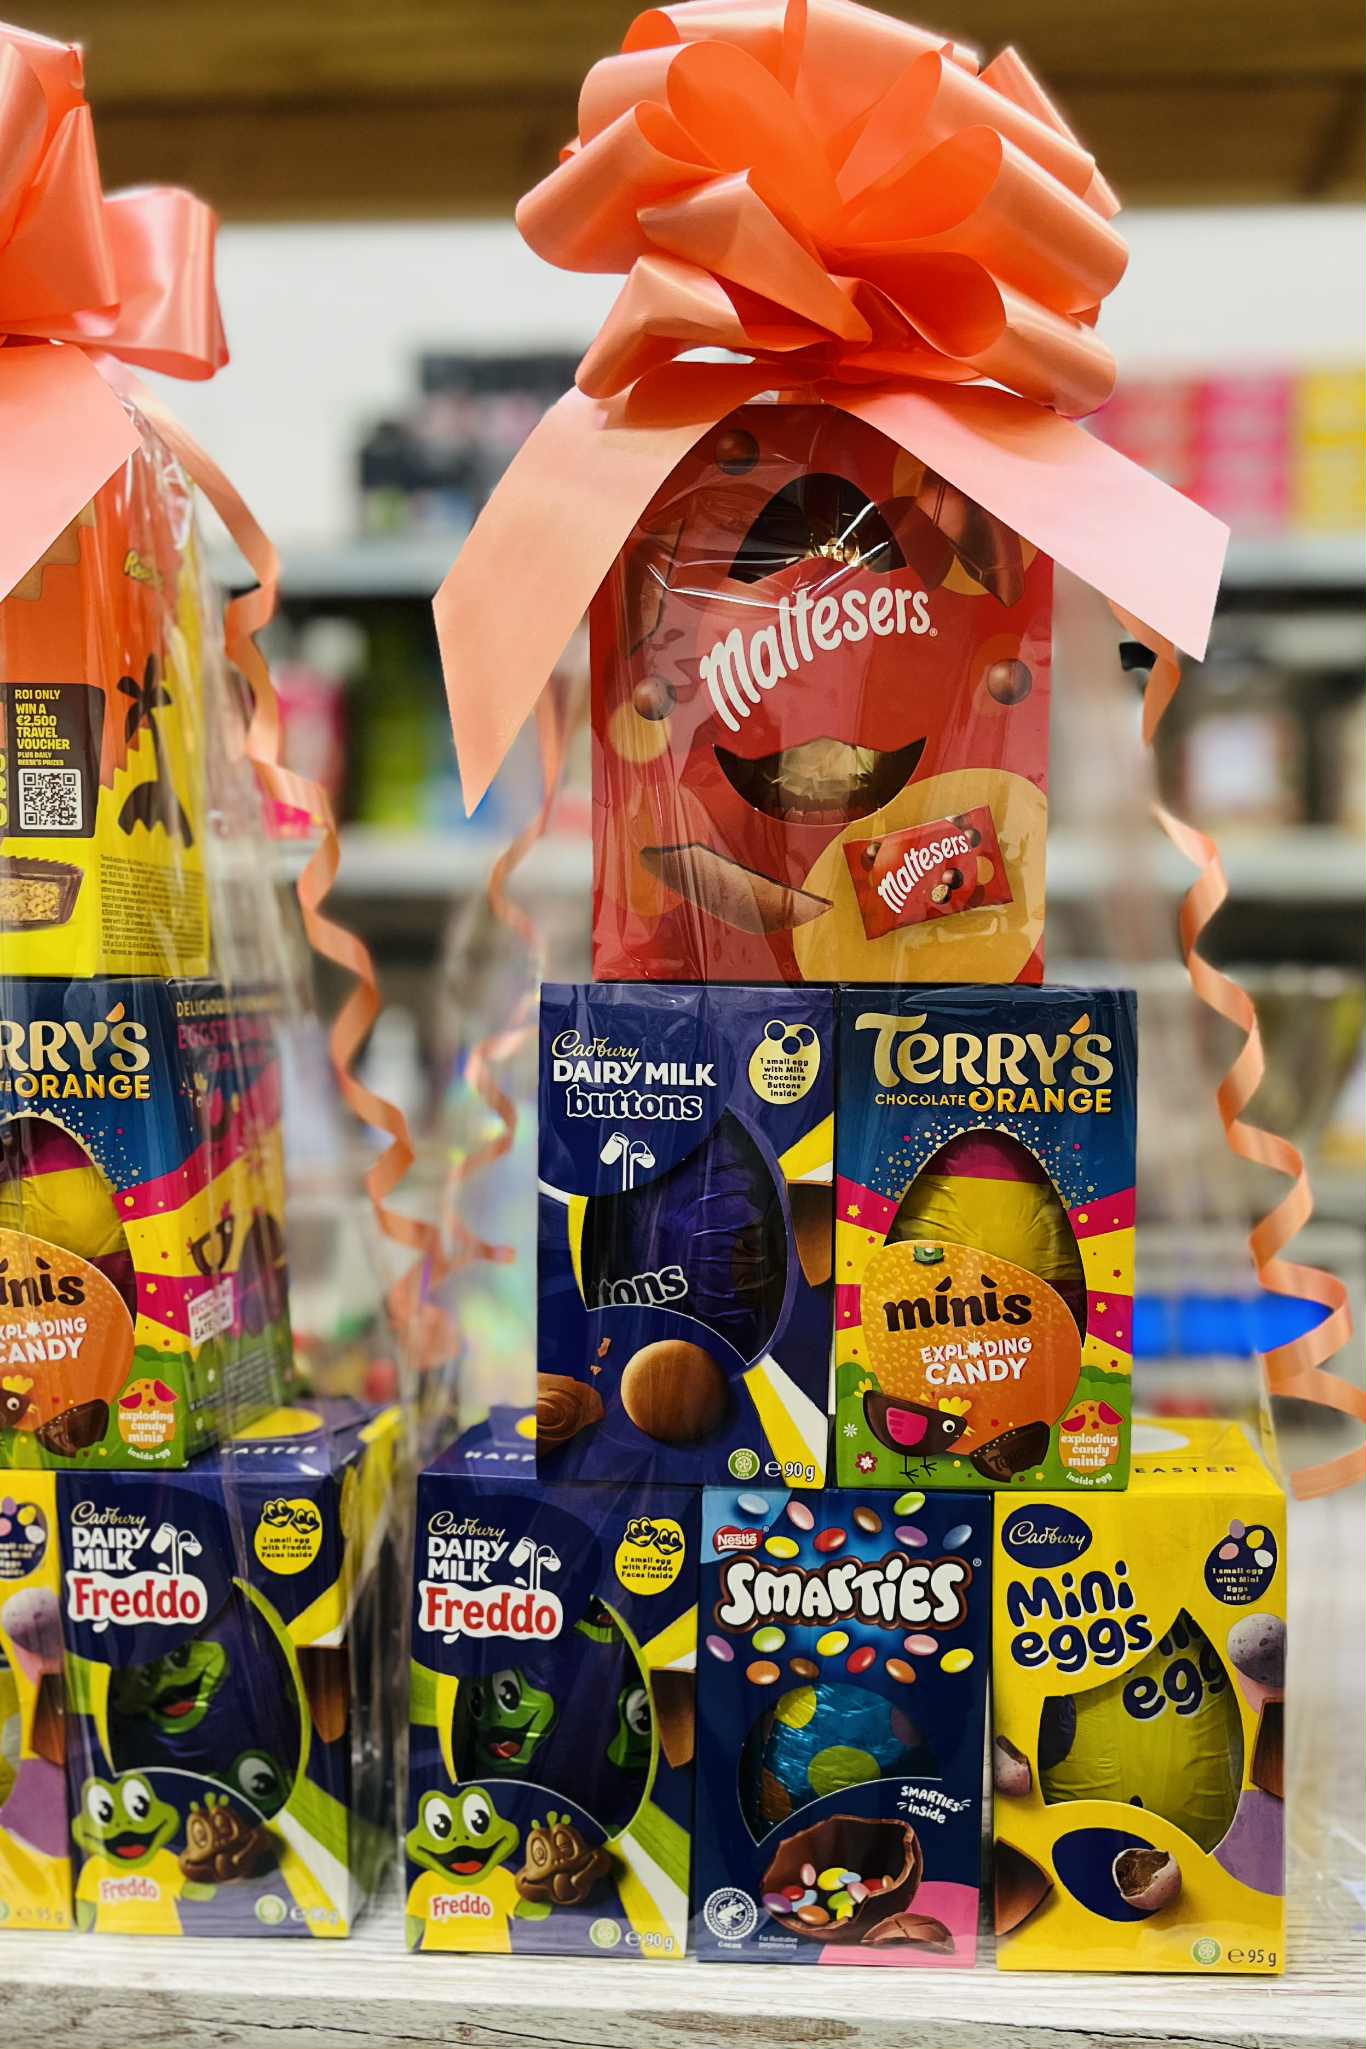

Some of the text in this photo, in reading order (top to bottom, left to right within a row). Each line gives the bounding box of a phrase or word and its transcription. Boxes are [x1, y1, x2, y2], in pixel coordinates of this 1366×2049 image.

[699, 586, 933, 733] Maltesers
[15, 689, 61, 700] ROI ONLY
[16, 704, 47, 714] WIN A
[16, 715, 57, 727] €2,500
[16, 727, 58, 738] TRAVEL
[17, 739, 70, 750] VOUCHER
[878, 835, 969, 914] Maltesers
[551, 1029, 640, 1065] Cadbury
[553, 1060, 718, 1087] DAIRY MILK
[762, 1074, 806, 1082] Chocolate
[14, 1073, 151, 1099] ORANGE
[566, 1084, 703, 1121] buttons
[875, 1087, 1113, 1114] CHOCOLATE ORANGE
[883, 1275, 1033, 1333] minis
[924, 1357, 1028, 1386] CANDY
[119, 1410, 174, 1424] exploding
[130, 1420, 166, 1434] candy
[1061, 1432, 1119, 1447] exploding
[1072, 1444, 1110, 1457] candy
[785, 1462, 803, 1477] 90
[805, 1465, 815, 1482] g
[1068, 1455, 1106, 1467] minis
[1134, 1466, 1238, 1474] EASTER
[1065, 1471, 1113, 1486] inside egg
[70, 1501, 146, 1531] Cadbury
[427, 1510, 506, 1544] Cadbury
[72, 1527, 151, 1550] DAIRY
[1008, 1520, 1087, 1551] Cadbury
[73, 1548, 137, 1571] MILK
[427, 1537, 510, 1562] DAIRY
[427, 1558, 493, 1583] MILK
[73, 1577, 201, 1619] Freddo
[1006, 1560, 1134, 1628] Mini
[1226, 1585, 1248, 1593] Eggs
[425, 1587, 557, 1634] Freddo
[1010, 1613, 1154, 1674] eggs
[900, 1785, 961, 1813] SMARTIES
[907, 1798, 946, 1824] inside
[101, 1877, 157, 1899] Freddo
[433, 1895, 491, 1917] Freddo
[1248, 1948, 1264, 1964] 95
[1268, 1952, 1277, 1968] g
